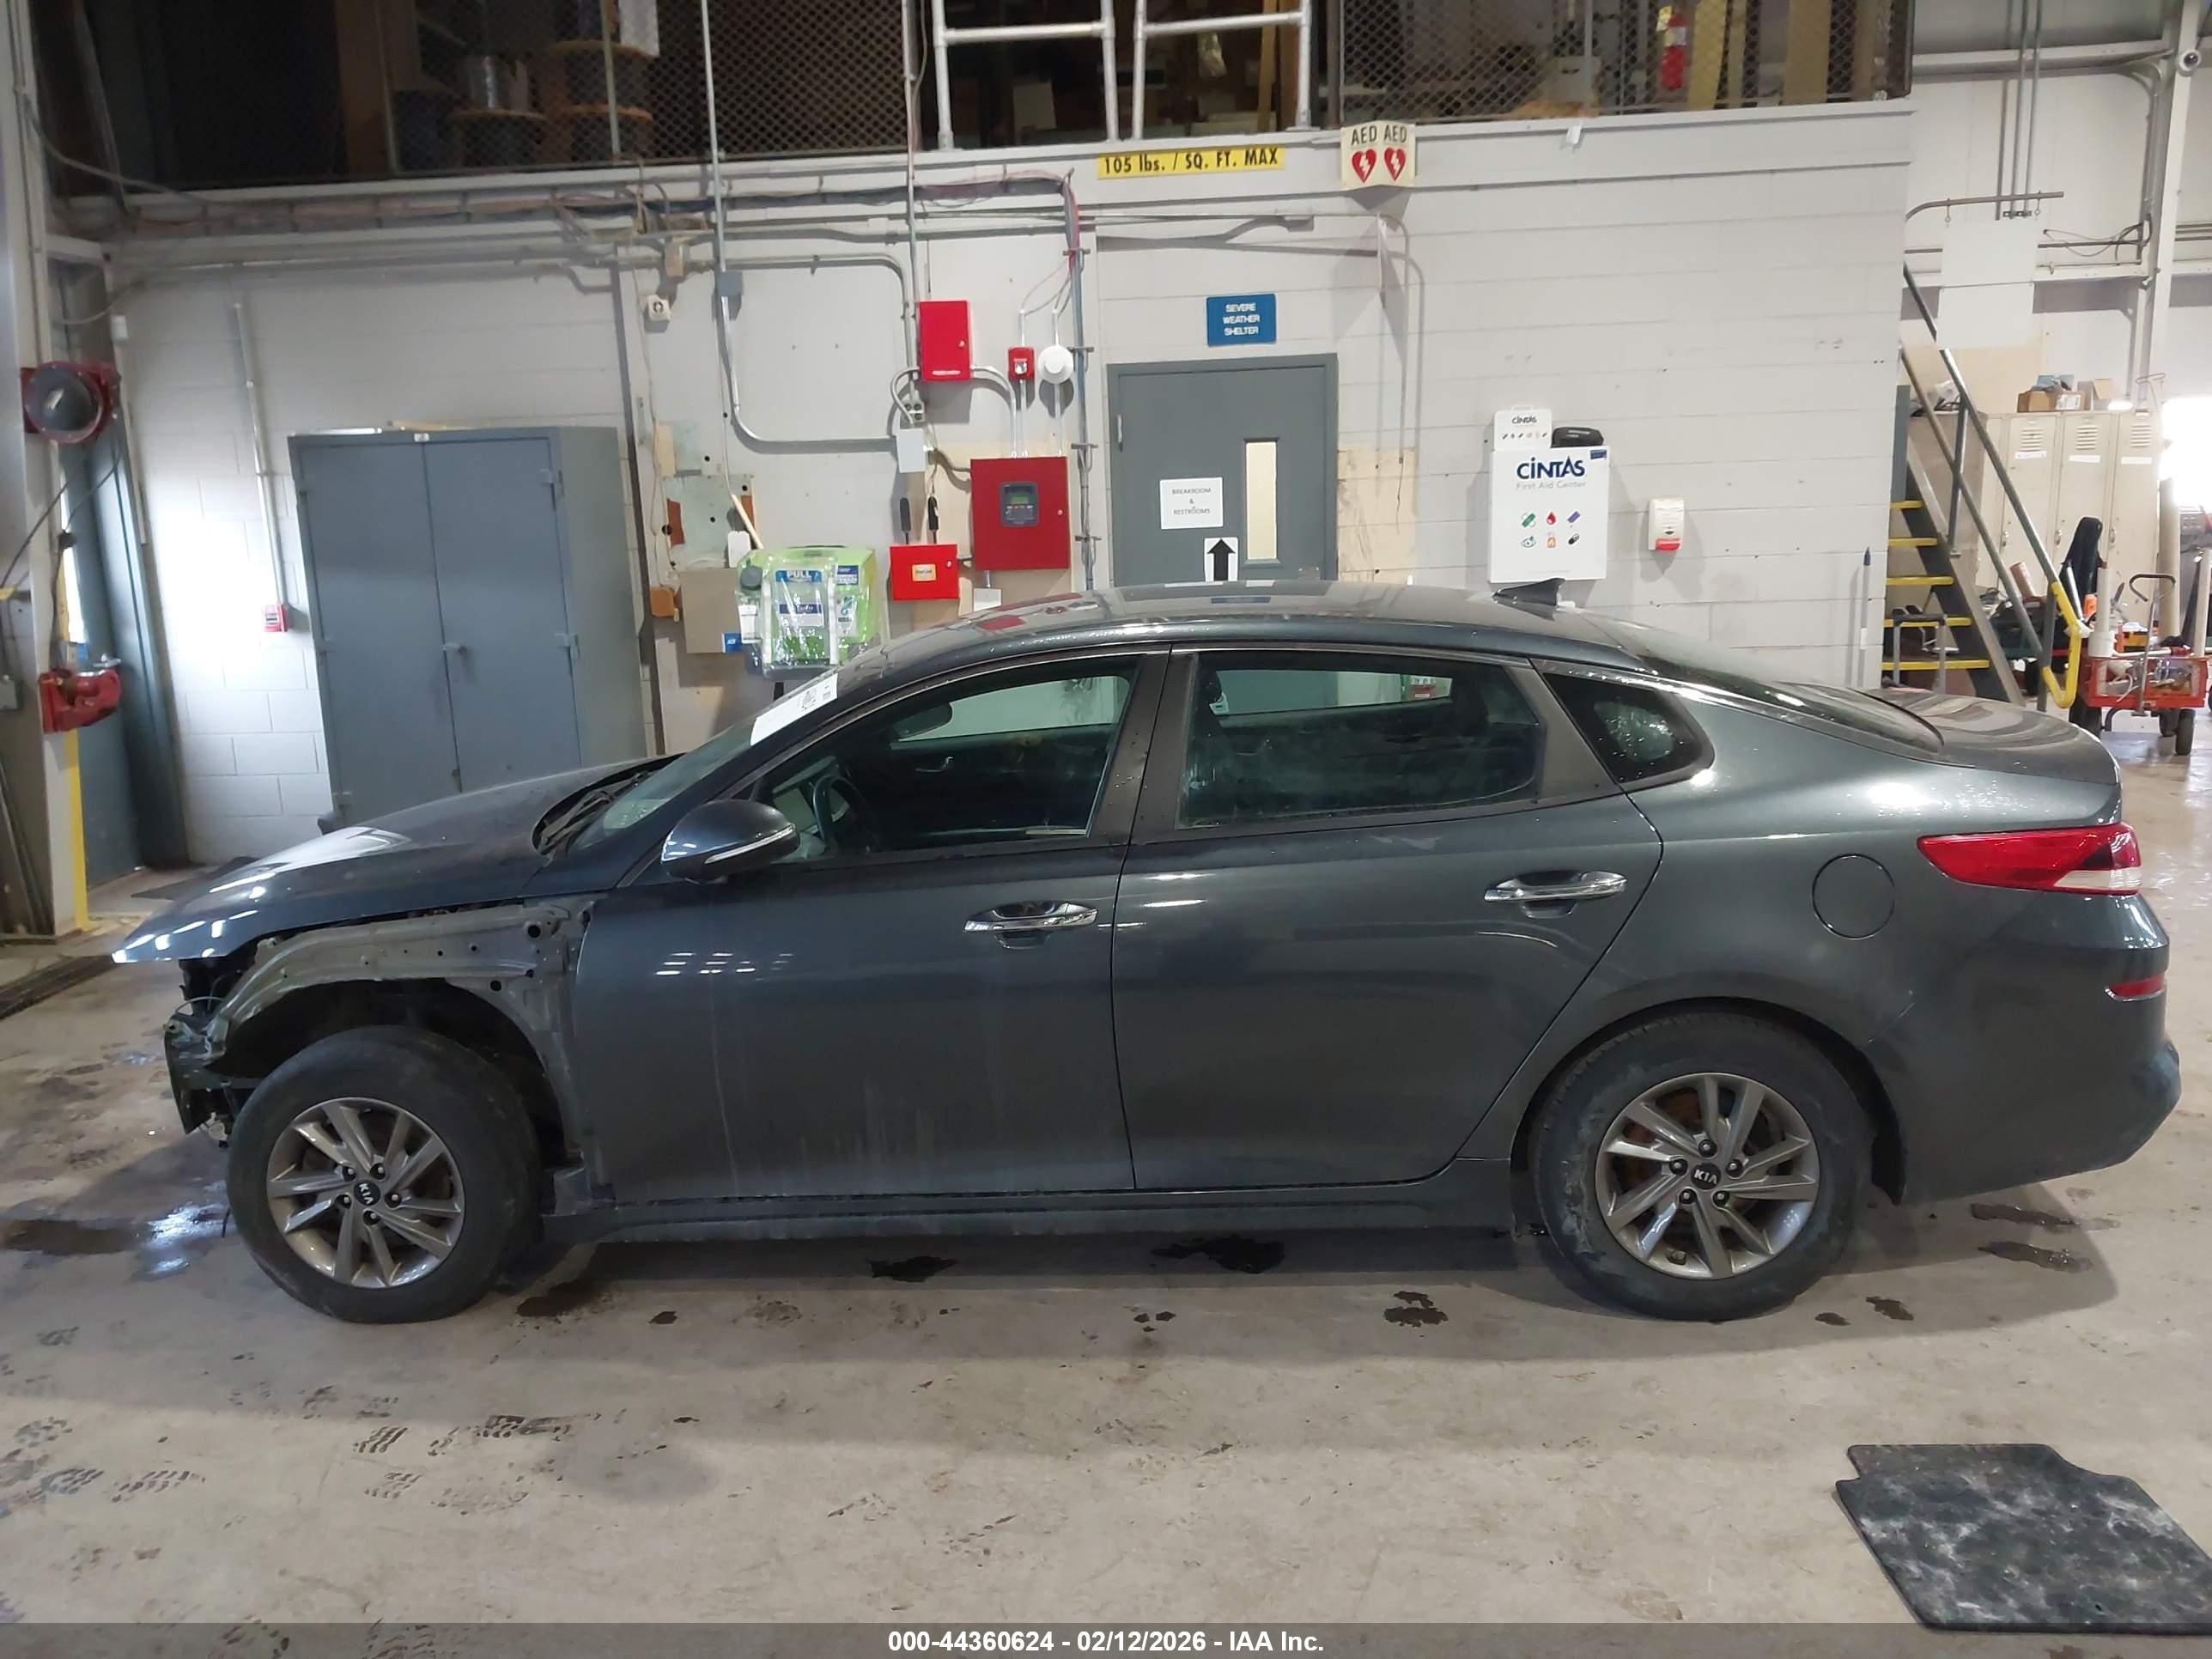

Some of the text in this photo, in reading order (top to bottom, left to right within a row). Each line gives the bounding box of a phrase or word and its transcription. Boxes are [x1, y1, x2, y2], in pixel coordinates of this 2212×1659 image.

[1351, 125, 1407, 146] AED AED
[1103, 148, 1279, 173] 105 lbs. / SQ. FT. MAX
[1225, 302, 1256, 313] SEVERE
[1223, 314, 1261, 325] WEATHER
[1224, 326, 1259, 336] SHELTER
[1693, 1169, 1717, 1184] KIA
[358, 1182, 374, 1204] KIA
